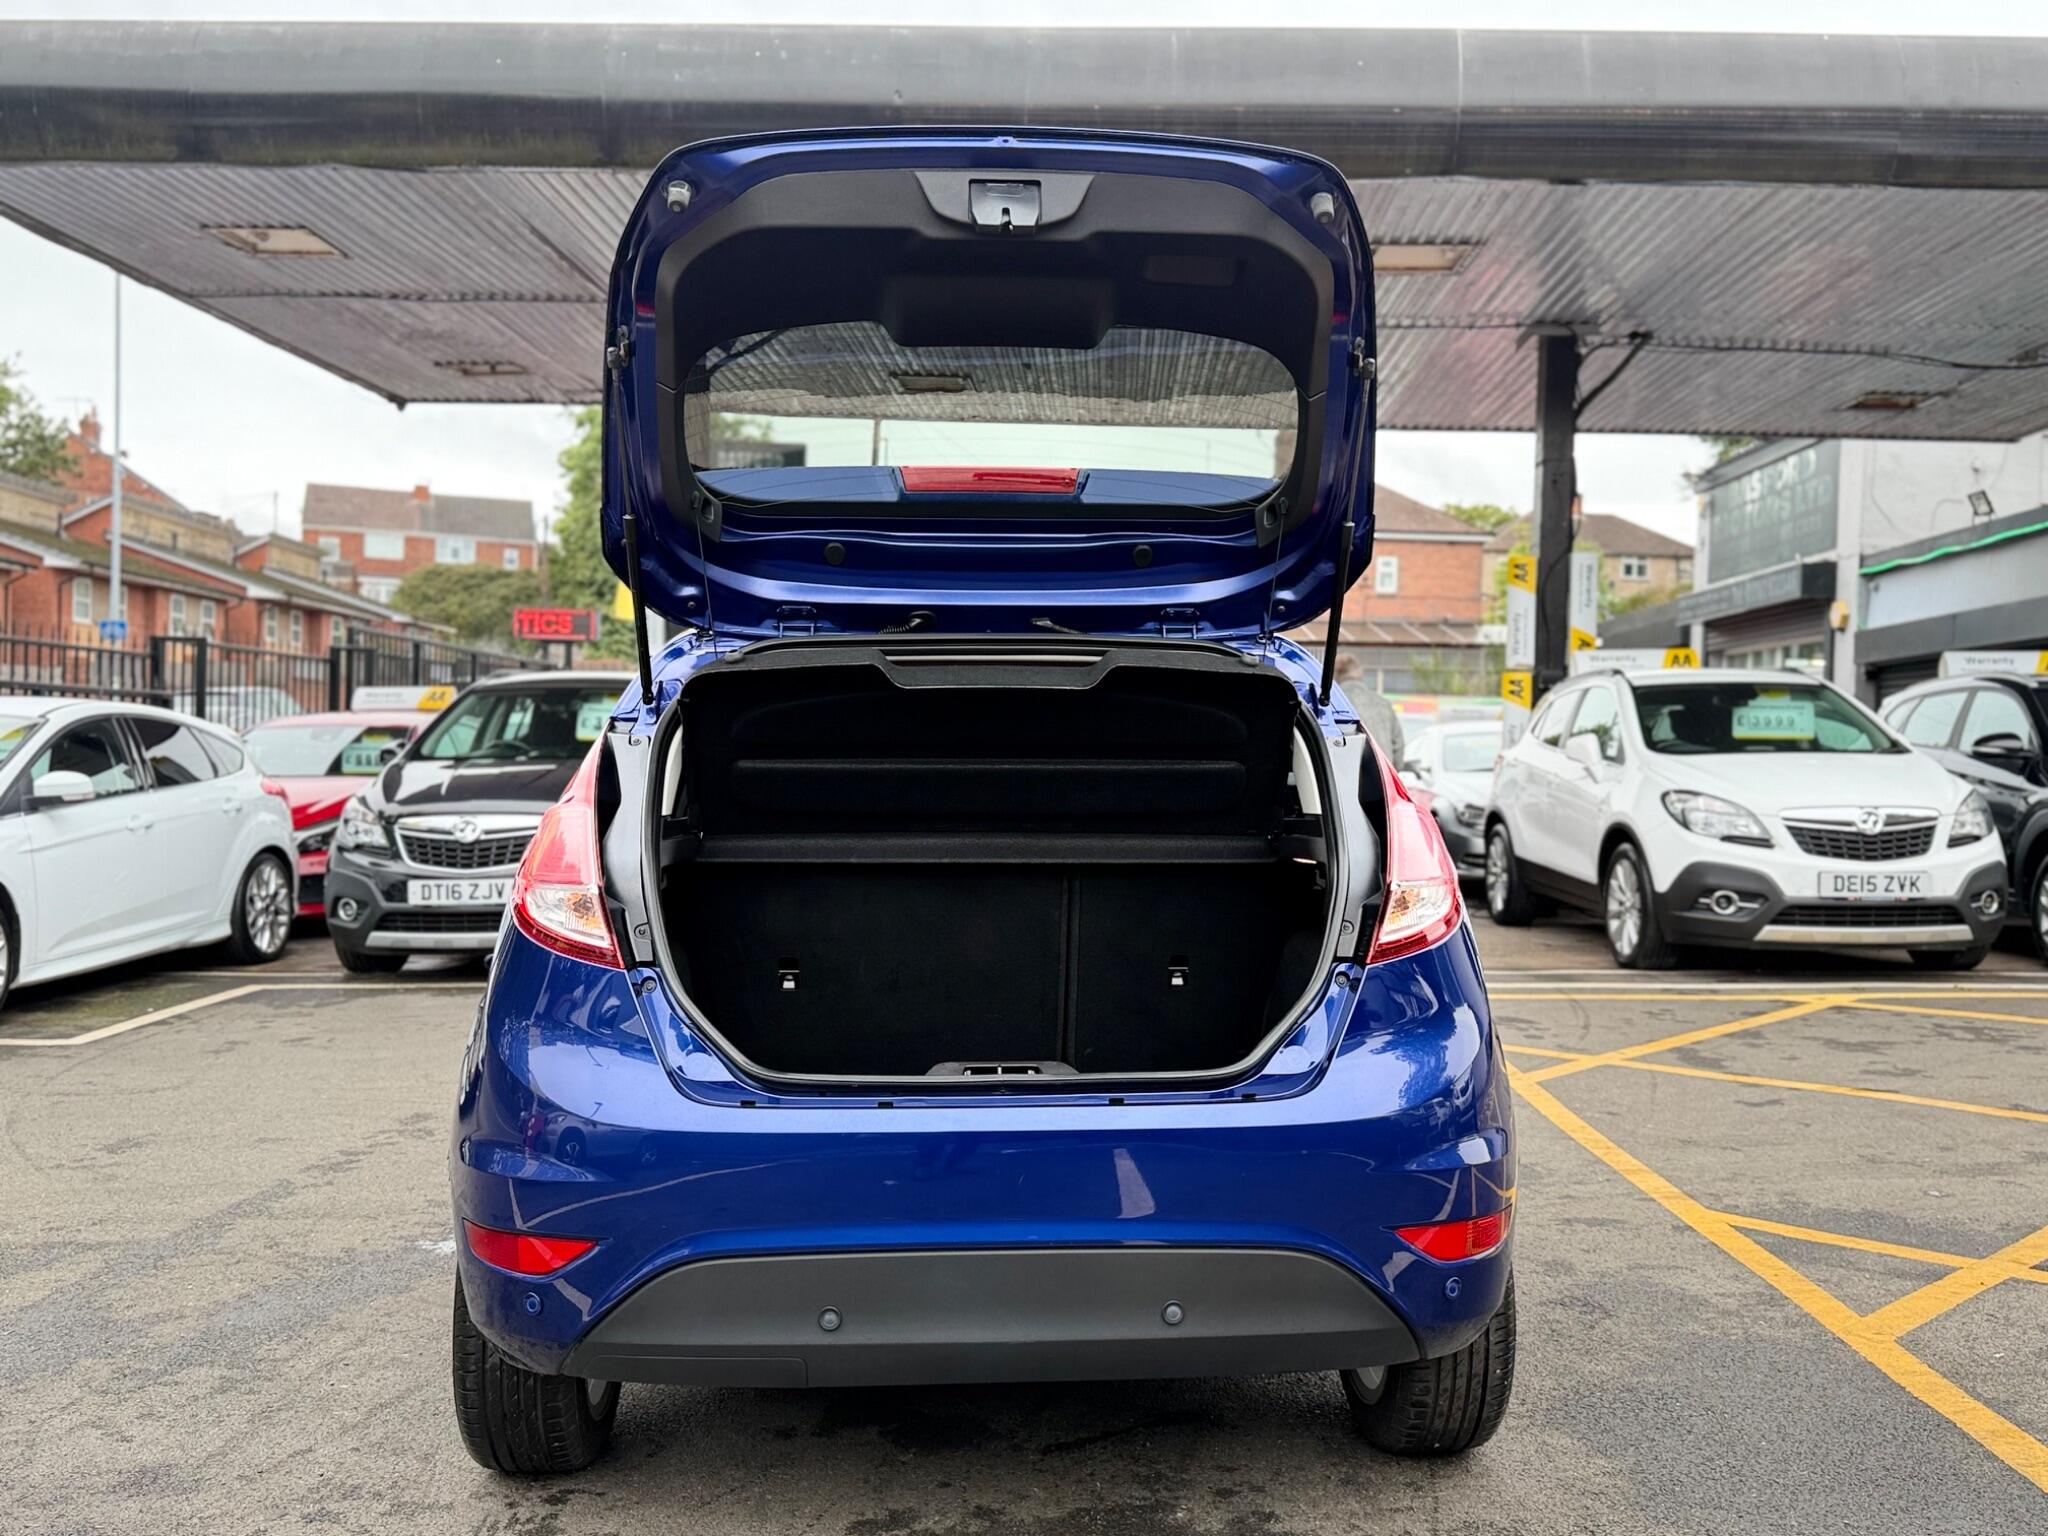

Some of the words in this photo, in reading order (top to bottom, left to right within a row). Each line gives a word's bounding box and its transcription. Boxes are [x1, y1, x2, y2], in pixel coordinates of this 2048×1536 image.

[1513, 562, 1529, 583] AA
[1670, 653, 1692, 668] AA
[1508, 678, 1525, 700] AA
[421, 883, 462, 901] DT16
[469, 882, 505, 901] ZJV
[1833, 875, 1877, 893] DE15
[1884, 875, 1921, 893] ZVK
